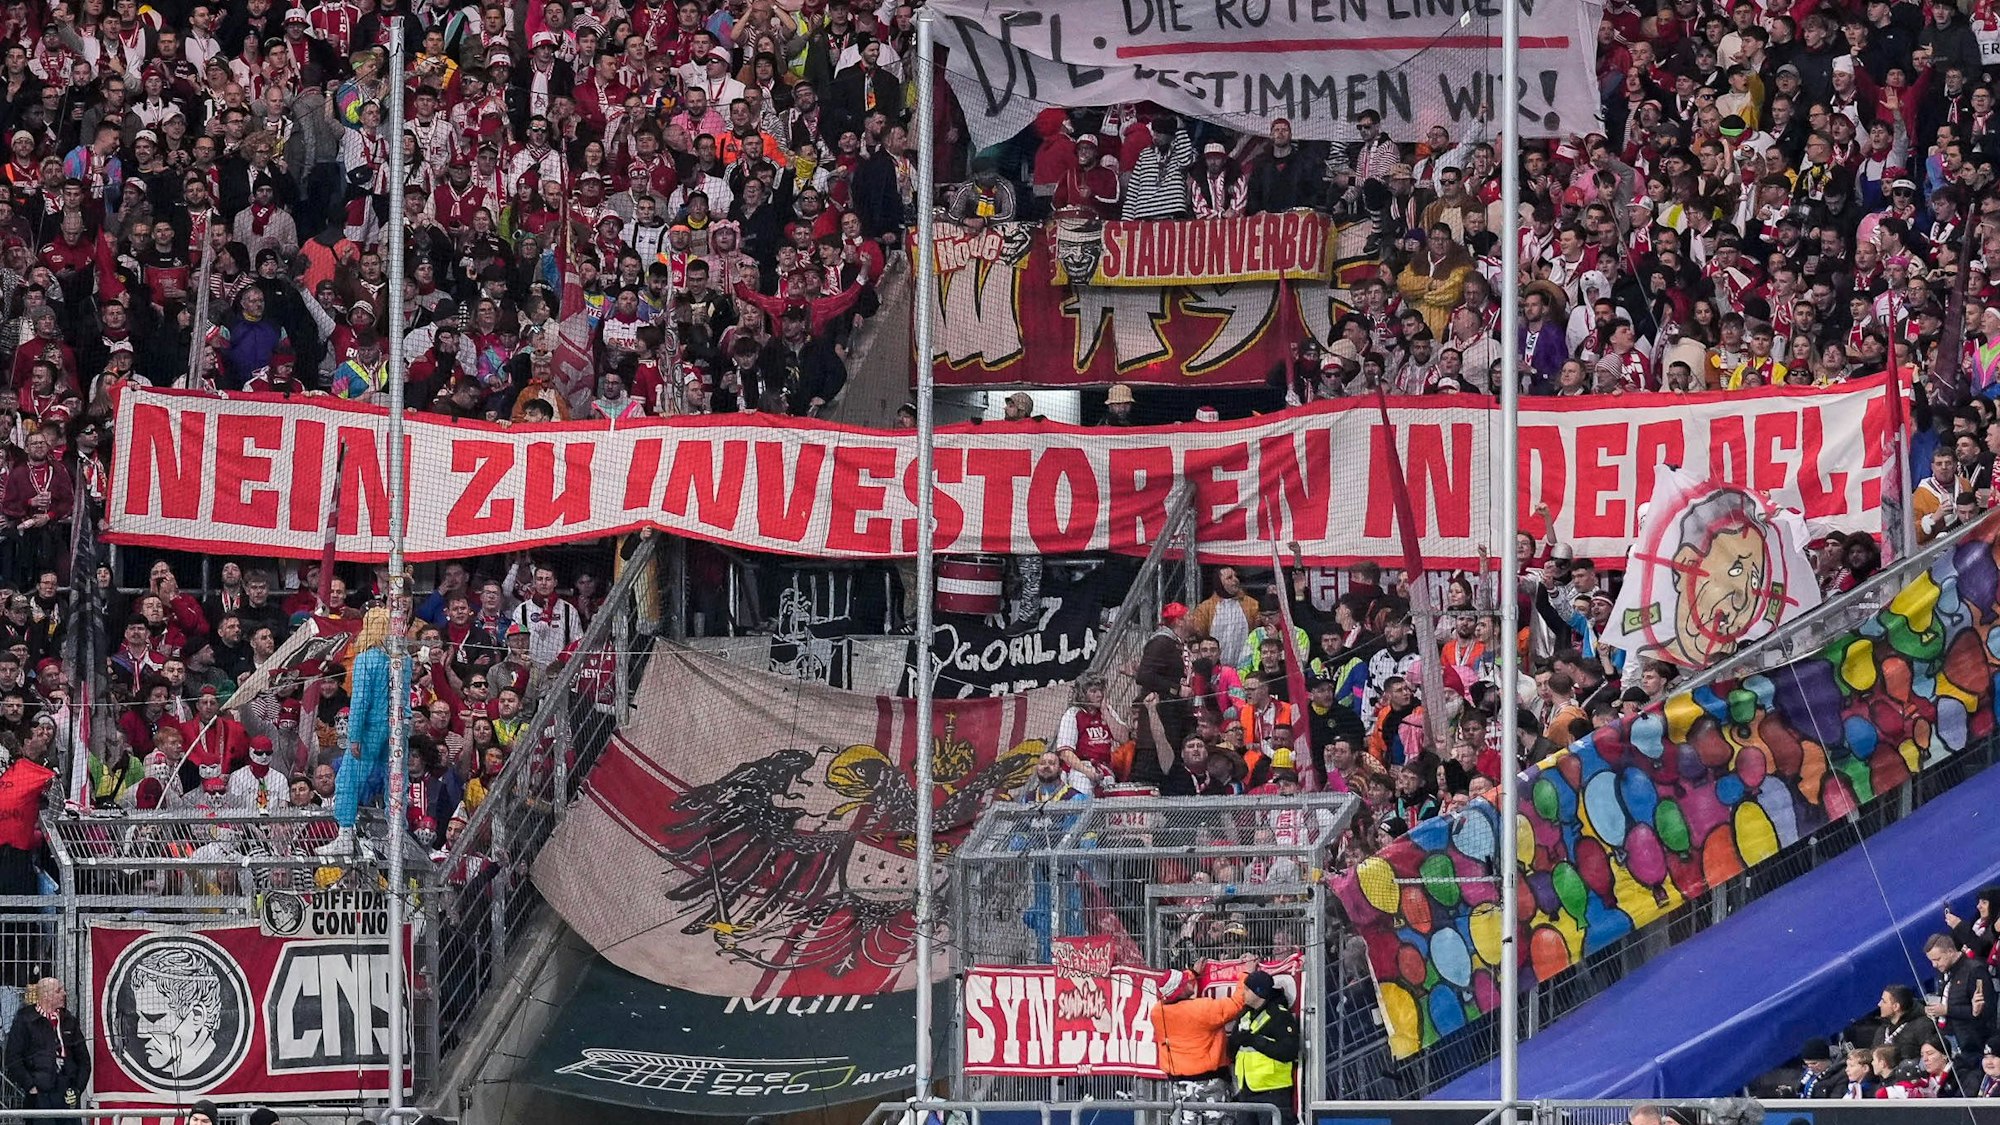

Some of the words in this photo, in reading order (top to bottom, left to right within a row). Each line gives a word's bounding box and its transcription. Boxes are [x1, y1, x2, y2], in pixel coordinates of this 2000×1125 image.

[1122, 0, 1194, 35] DIE
[1438, 70, 1558, 132] WIR!
[1102, 214, 1330, 277] STADIONVERBOT
[124, 403, 411, 537] NEIN
[446, 440, 596, 537] ZU
[623, 428, 1332, 553] INVESTOREN
[1363, 422, 1474, 538] IN
[312, 890, 389, 910] DIFFIDA
[707, 1083, 810, 1096] zero
[852, 1063, 918, 1087] Aren
